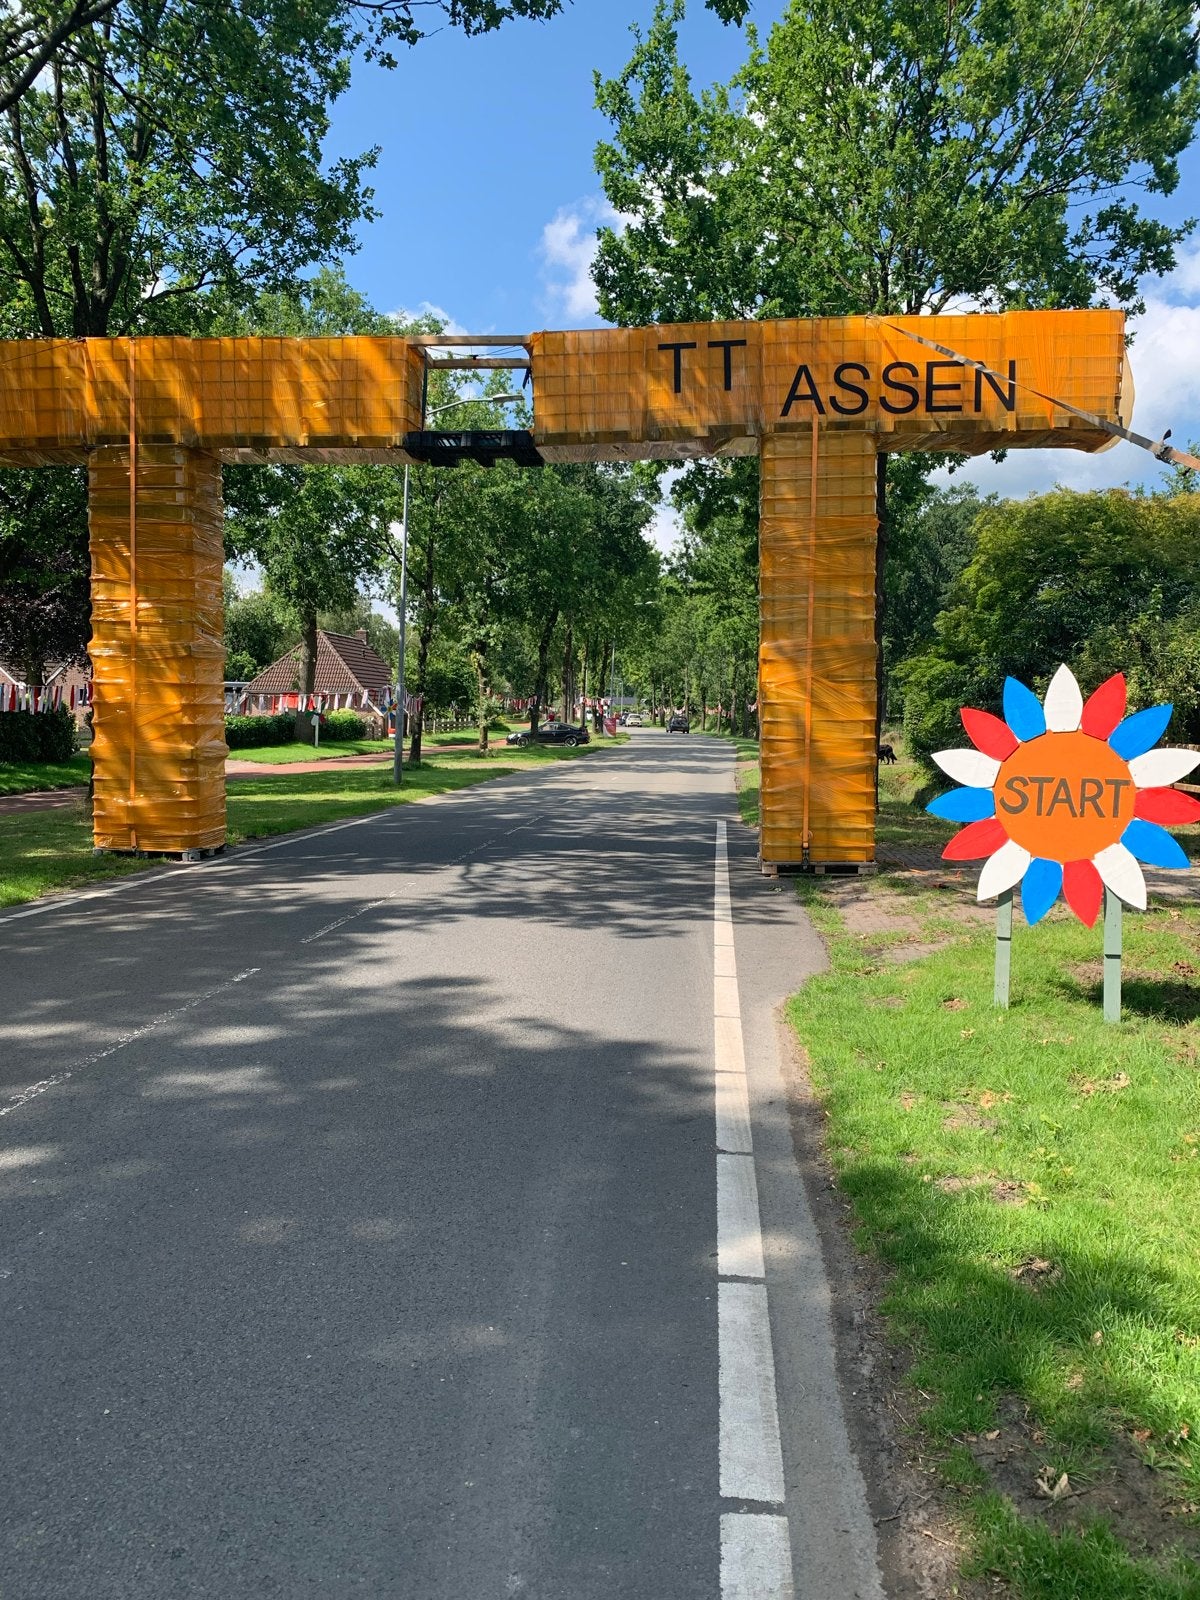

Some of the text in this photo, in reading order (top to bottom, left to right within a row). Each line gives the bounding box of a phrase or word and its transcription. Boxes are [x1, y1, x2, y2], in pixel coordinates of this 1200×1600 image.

[658, 339, 1016, 417] TT ASSEN
[999, 776, 1131, 818] START
